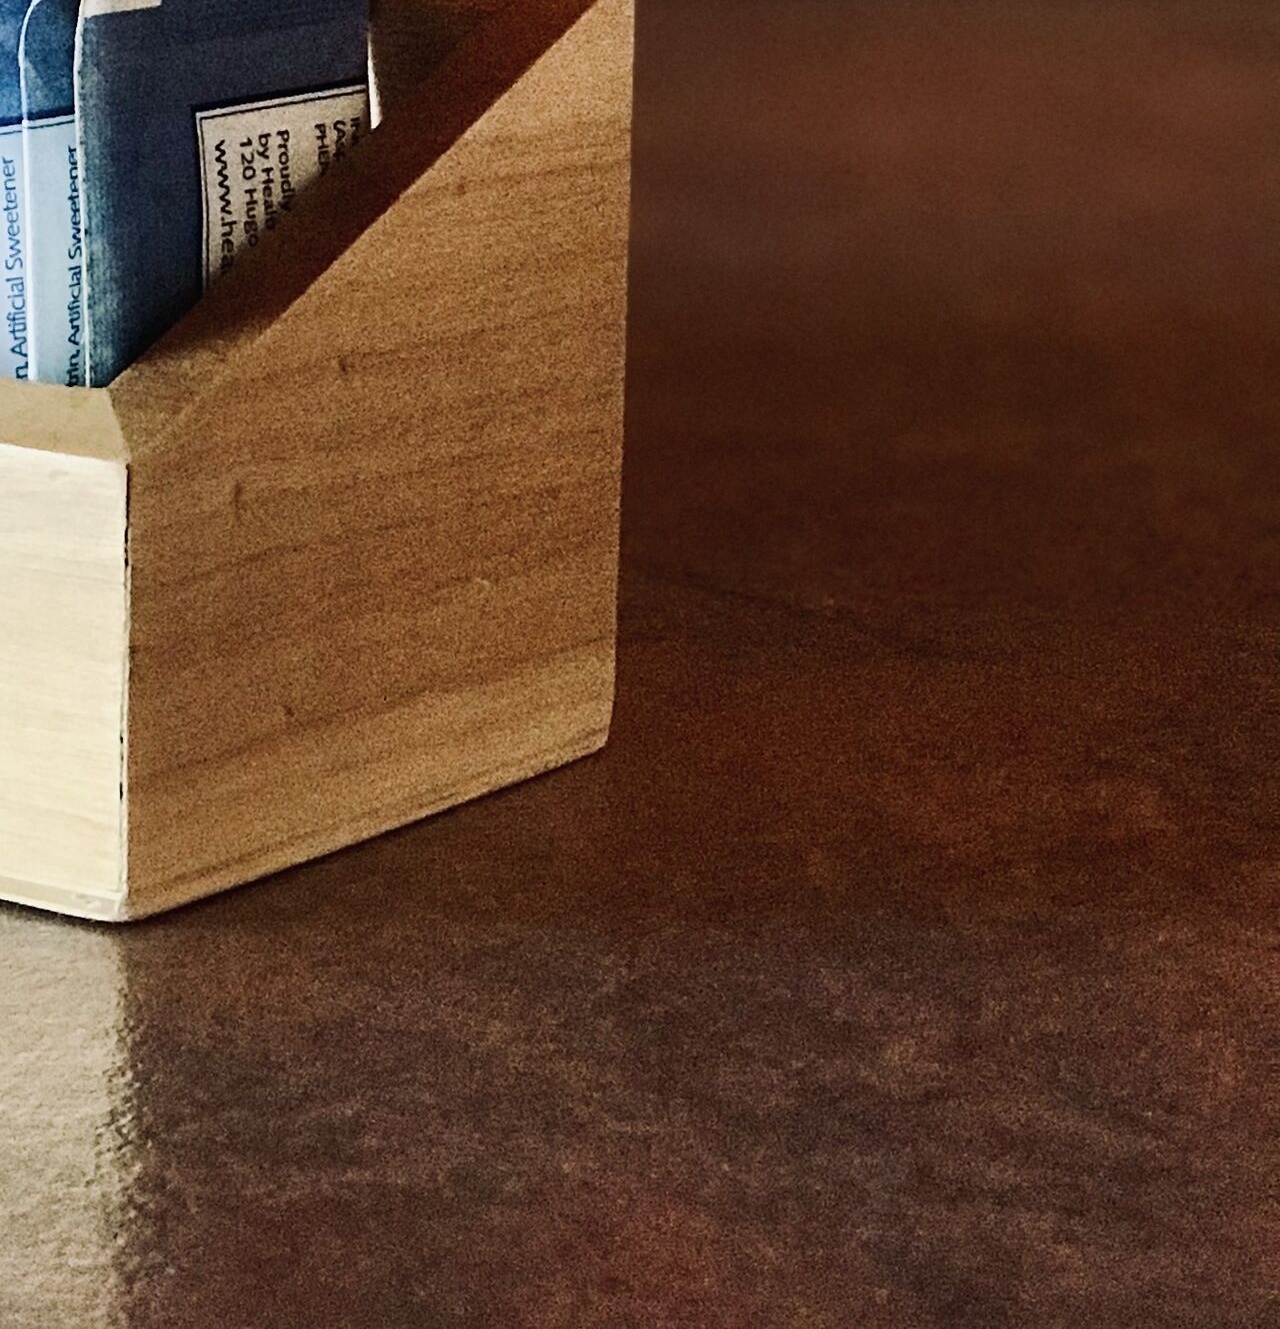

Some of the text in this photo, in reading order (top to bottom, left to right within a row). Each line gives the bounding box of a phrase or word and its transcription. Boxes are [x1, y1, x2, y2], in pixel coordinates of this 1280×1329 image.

[239, 136, 260, 248] 120 Hugo
[255, 132, 272, 161] by
[2, 156, 25, 271] Sweetener
[6, 276, 29, 359] Artificial
